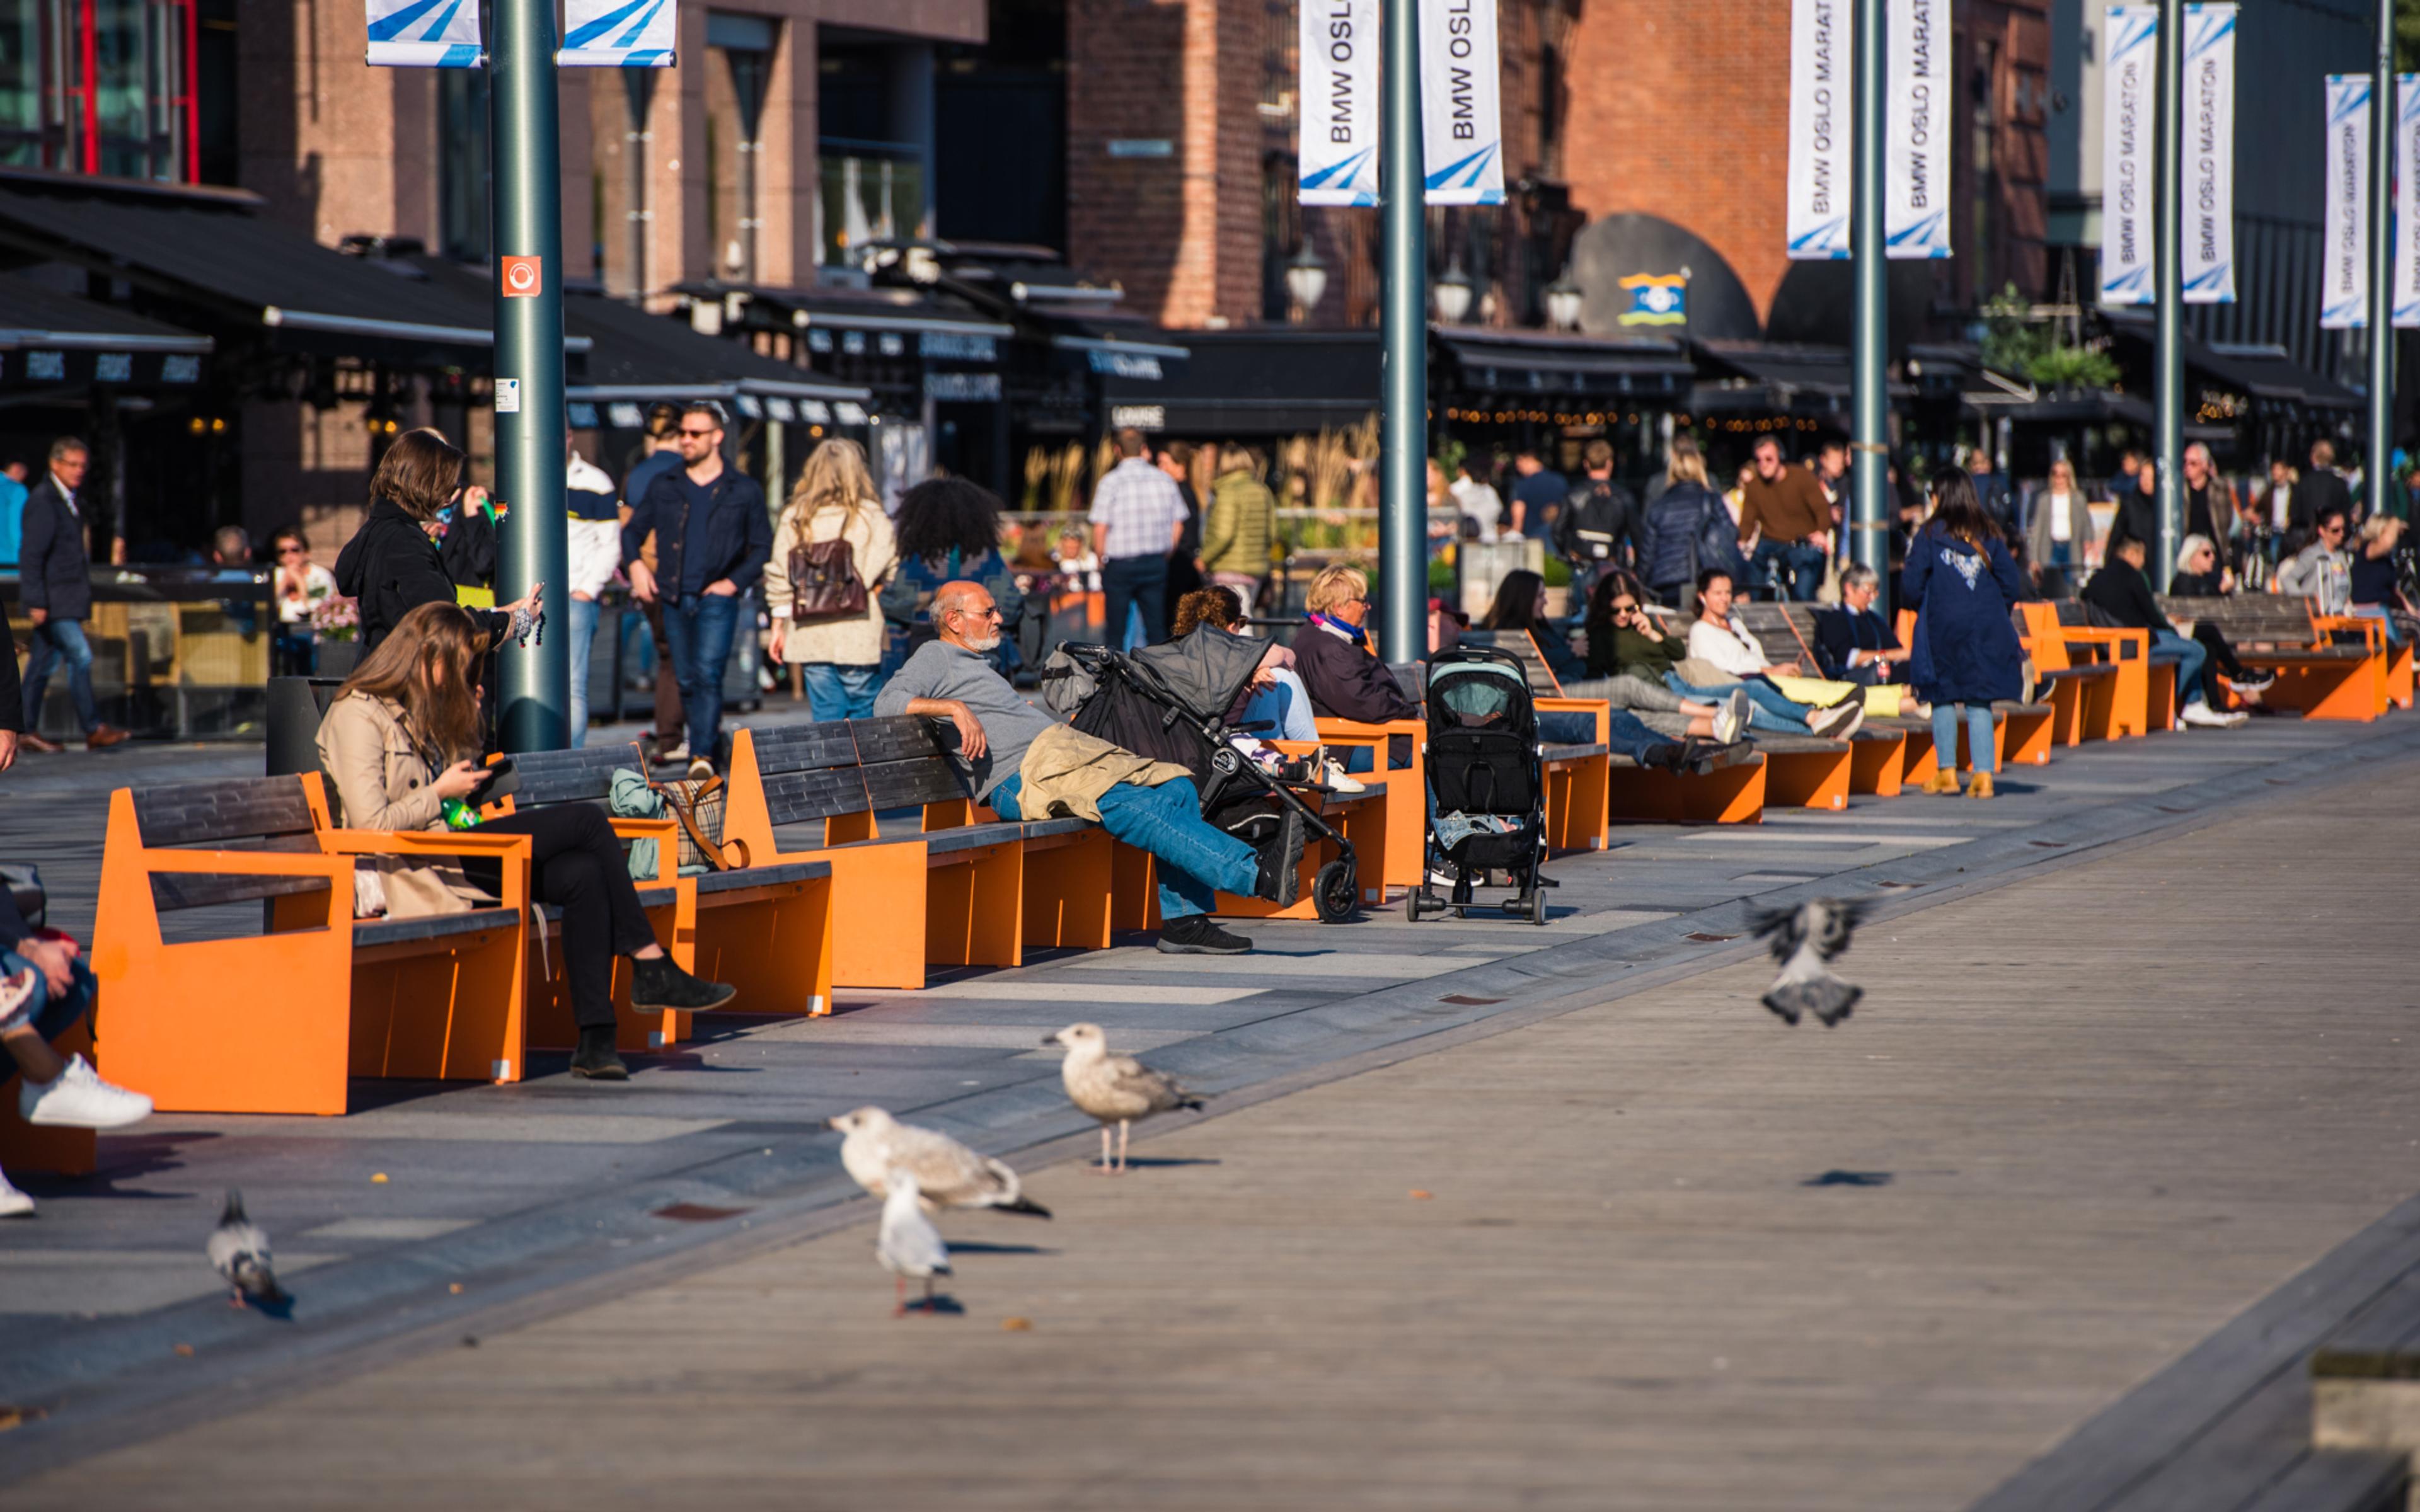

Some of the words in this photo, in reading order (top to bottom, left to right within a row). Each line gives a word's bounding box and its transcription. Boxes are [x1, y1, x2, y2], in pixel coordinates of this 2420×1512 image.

[1330, 0, 1353, 62] OSL
[1815, 1, 1831, 81] MARAT
[1331, 70, 1352, 143] BMW
[1450, 67, 1473, 139] BMW
[1814, 88, 1831, 152] OSLO
[1911, 84, 1930, 146] OSLO
[2120, 61, 2137, 156] MARATON
[2200, 59, 2216, 153] MARATON
[1813, 158, 1831, 214] BMW
[1911, 151, 1928, 209] BMW
[2119, 159, 2136, 214] OSLO
[2199, 157, 2215, 212] OSLO
[2119, 216, 2136, 264] BMW
[2200, 214, 2216, 262] BMW
